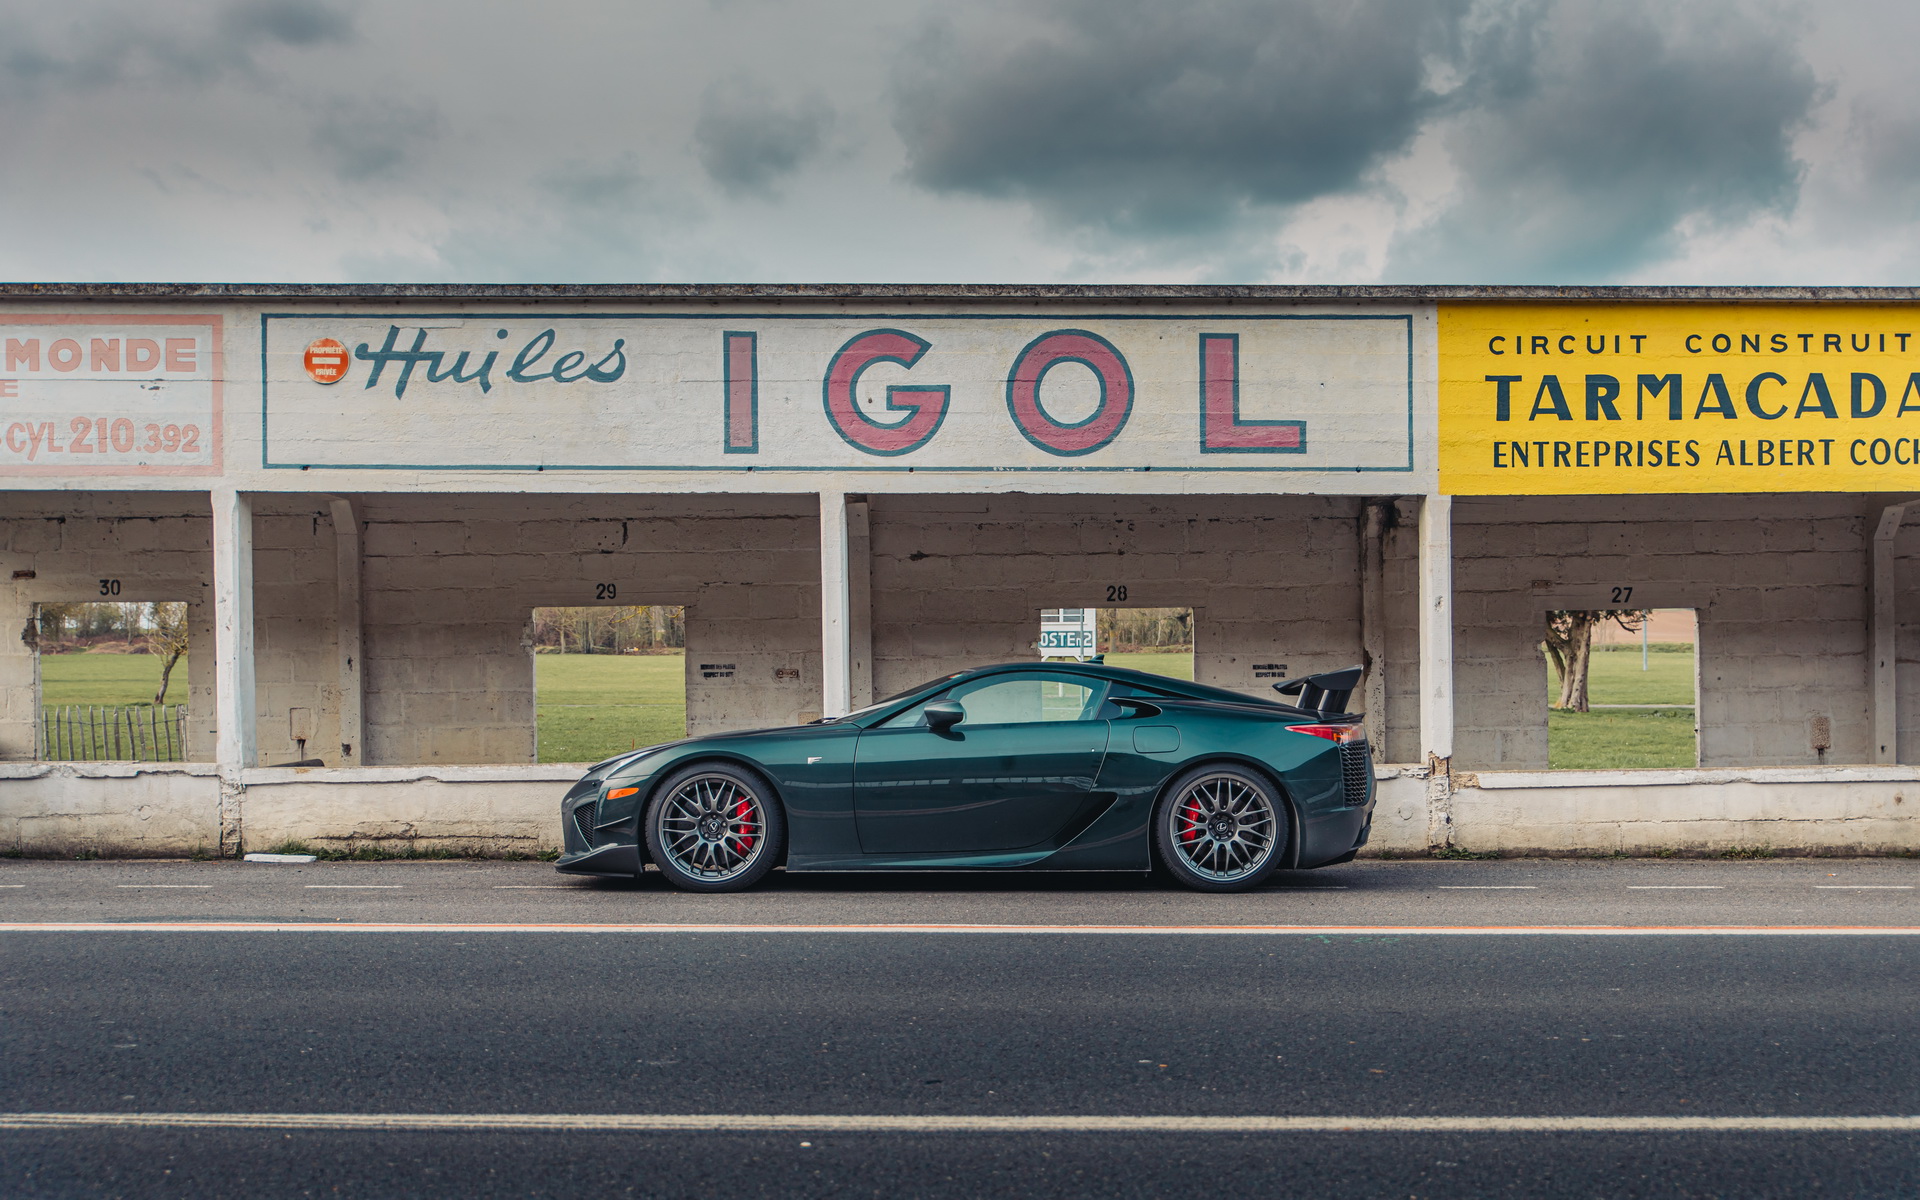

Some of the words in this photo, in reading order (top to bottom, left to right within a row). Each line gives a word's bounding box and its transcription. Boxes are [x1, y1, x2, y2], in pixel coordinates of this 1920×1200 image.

[6, 338, 196, 372] MONDE
[1489, 335, 1647, 355] CIRCUIT
[1685, 333, 1911, 353] CONSTRUIT
[354, 325, 627, 400] Huiles
[723, 328, 1307, 457] IGOL
[69, 416, 200, 453] 210.392
[1493, 440, 1700, 468] ENTREPRISES
[1716, 439, 1836, 466] ALBERT
[99, 579, 121, 596] 30
[595, 583, 617, 600] 29
[1106, 585, 1128, 602] 28
[1611, 587, 1633, 603] 27
